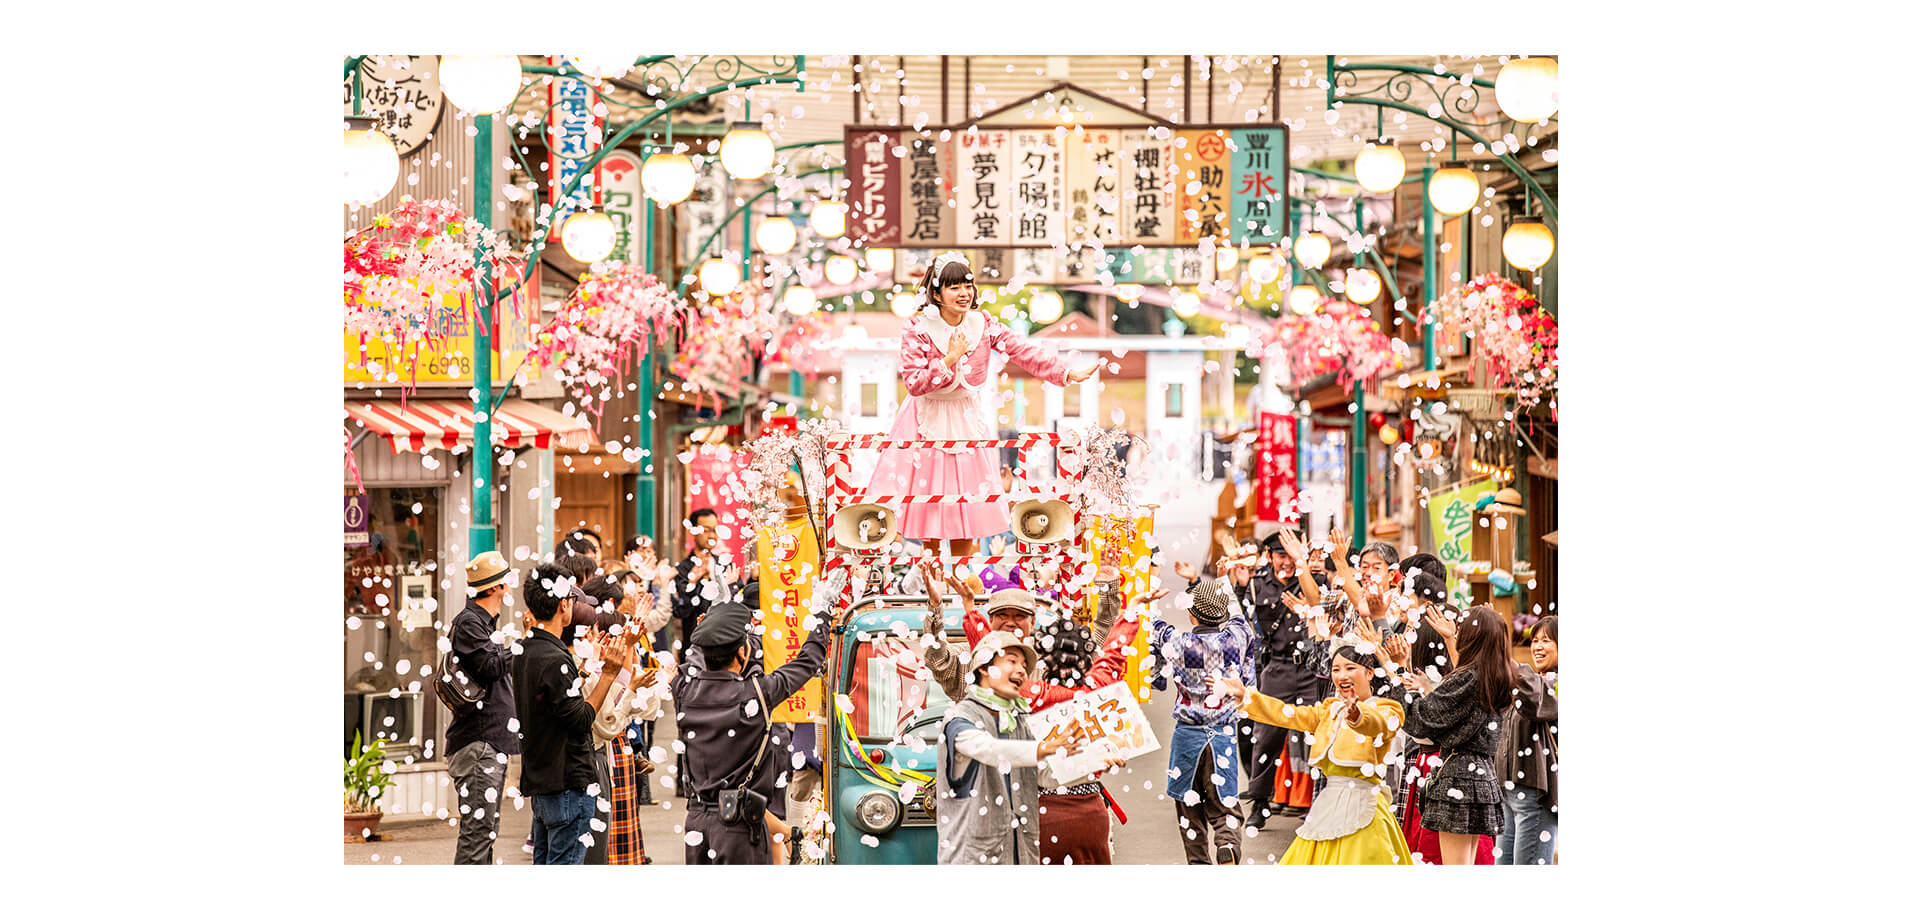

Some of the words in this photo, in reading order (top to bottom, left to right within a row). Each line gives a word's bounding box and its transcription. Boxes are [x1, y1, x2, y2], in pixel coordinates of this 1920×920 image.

[972, 152, 1000, 240] 夢見堂
[1018, 152, 1049, 239] 夕陽館
[780, 568, 808, 713] 夕日の丘街
